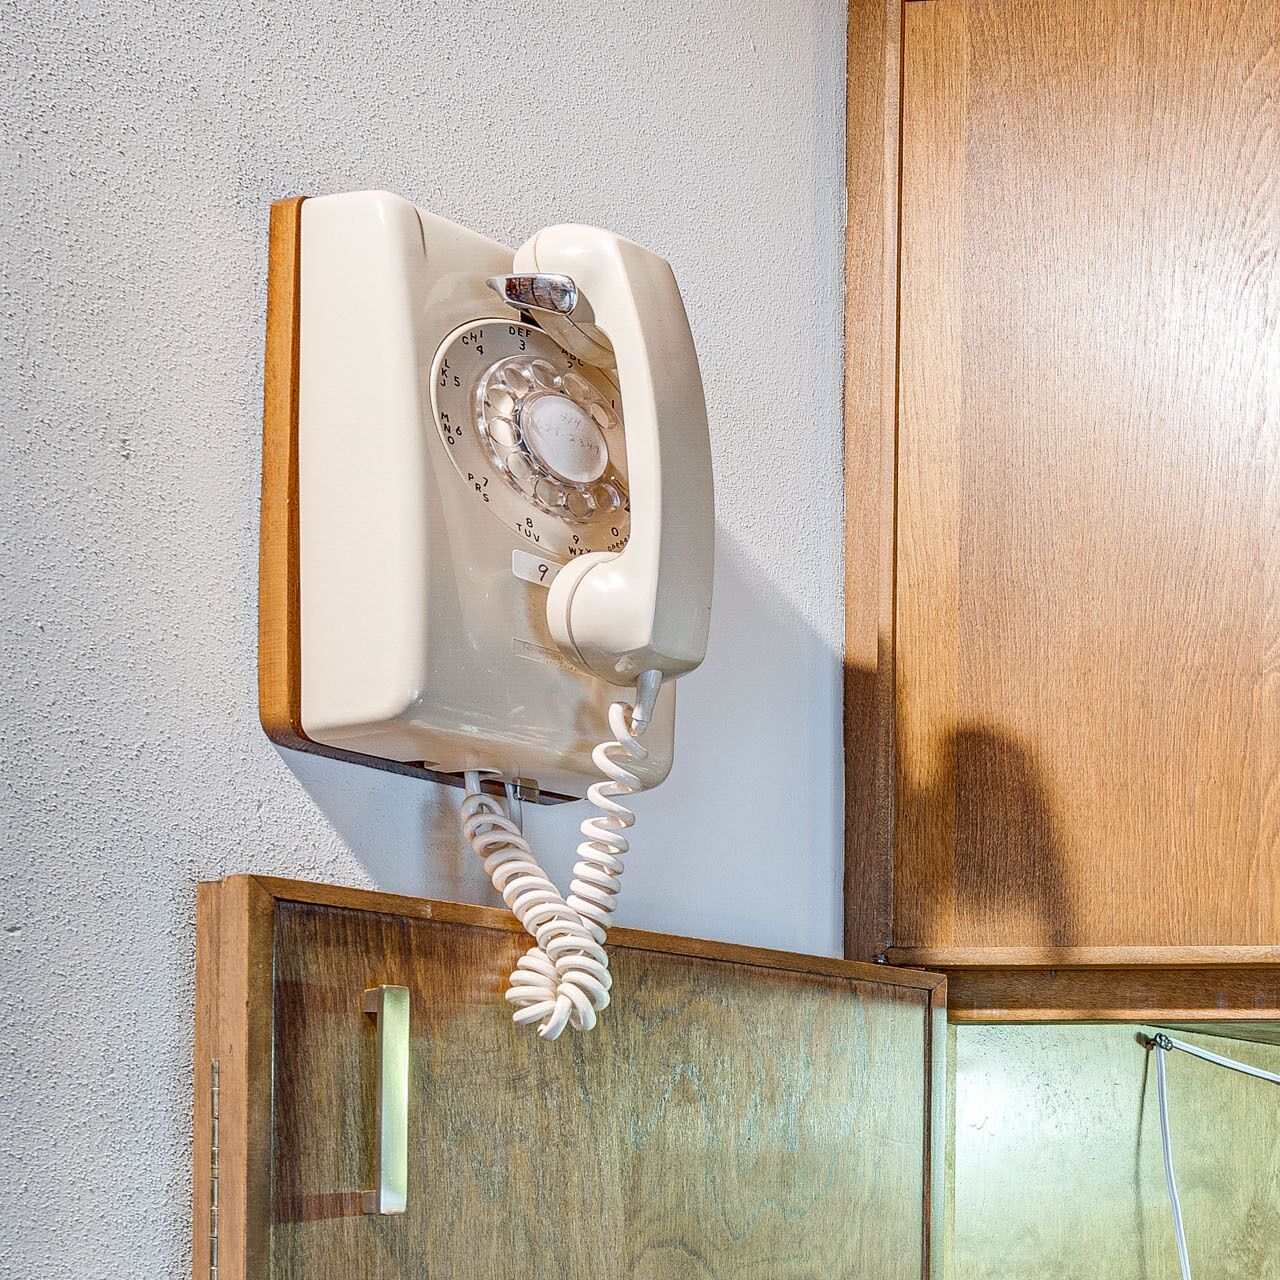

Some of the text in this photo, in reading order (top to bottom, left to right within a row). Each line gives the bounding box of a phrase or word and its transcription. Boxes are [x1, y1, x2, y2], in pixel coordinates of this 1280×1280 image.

[461, 329, 483, 345] GHI
[508, 326, 532, 338] DEF
[476, 344, 485, 355] 4
[519, 339, 526, 351] 3
[453, 376, 461, 387] 5
[455, 427, 463, 436] 6
[482, 476, 489, 488] 7
[525, 517, 533, 528] 8
[516, 522, 540, 543] TUV
[572, 534, 580, 544] 9
